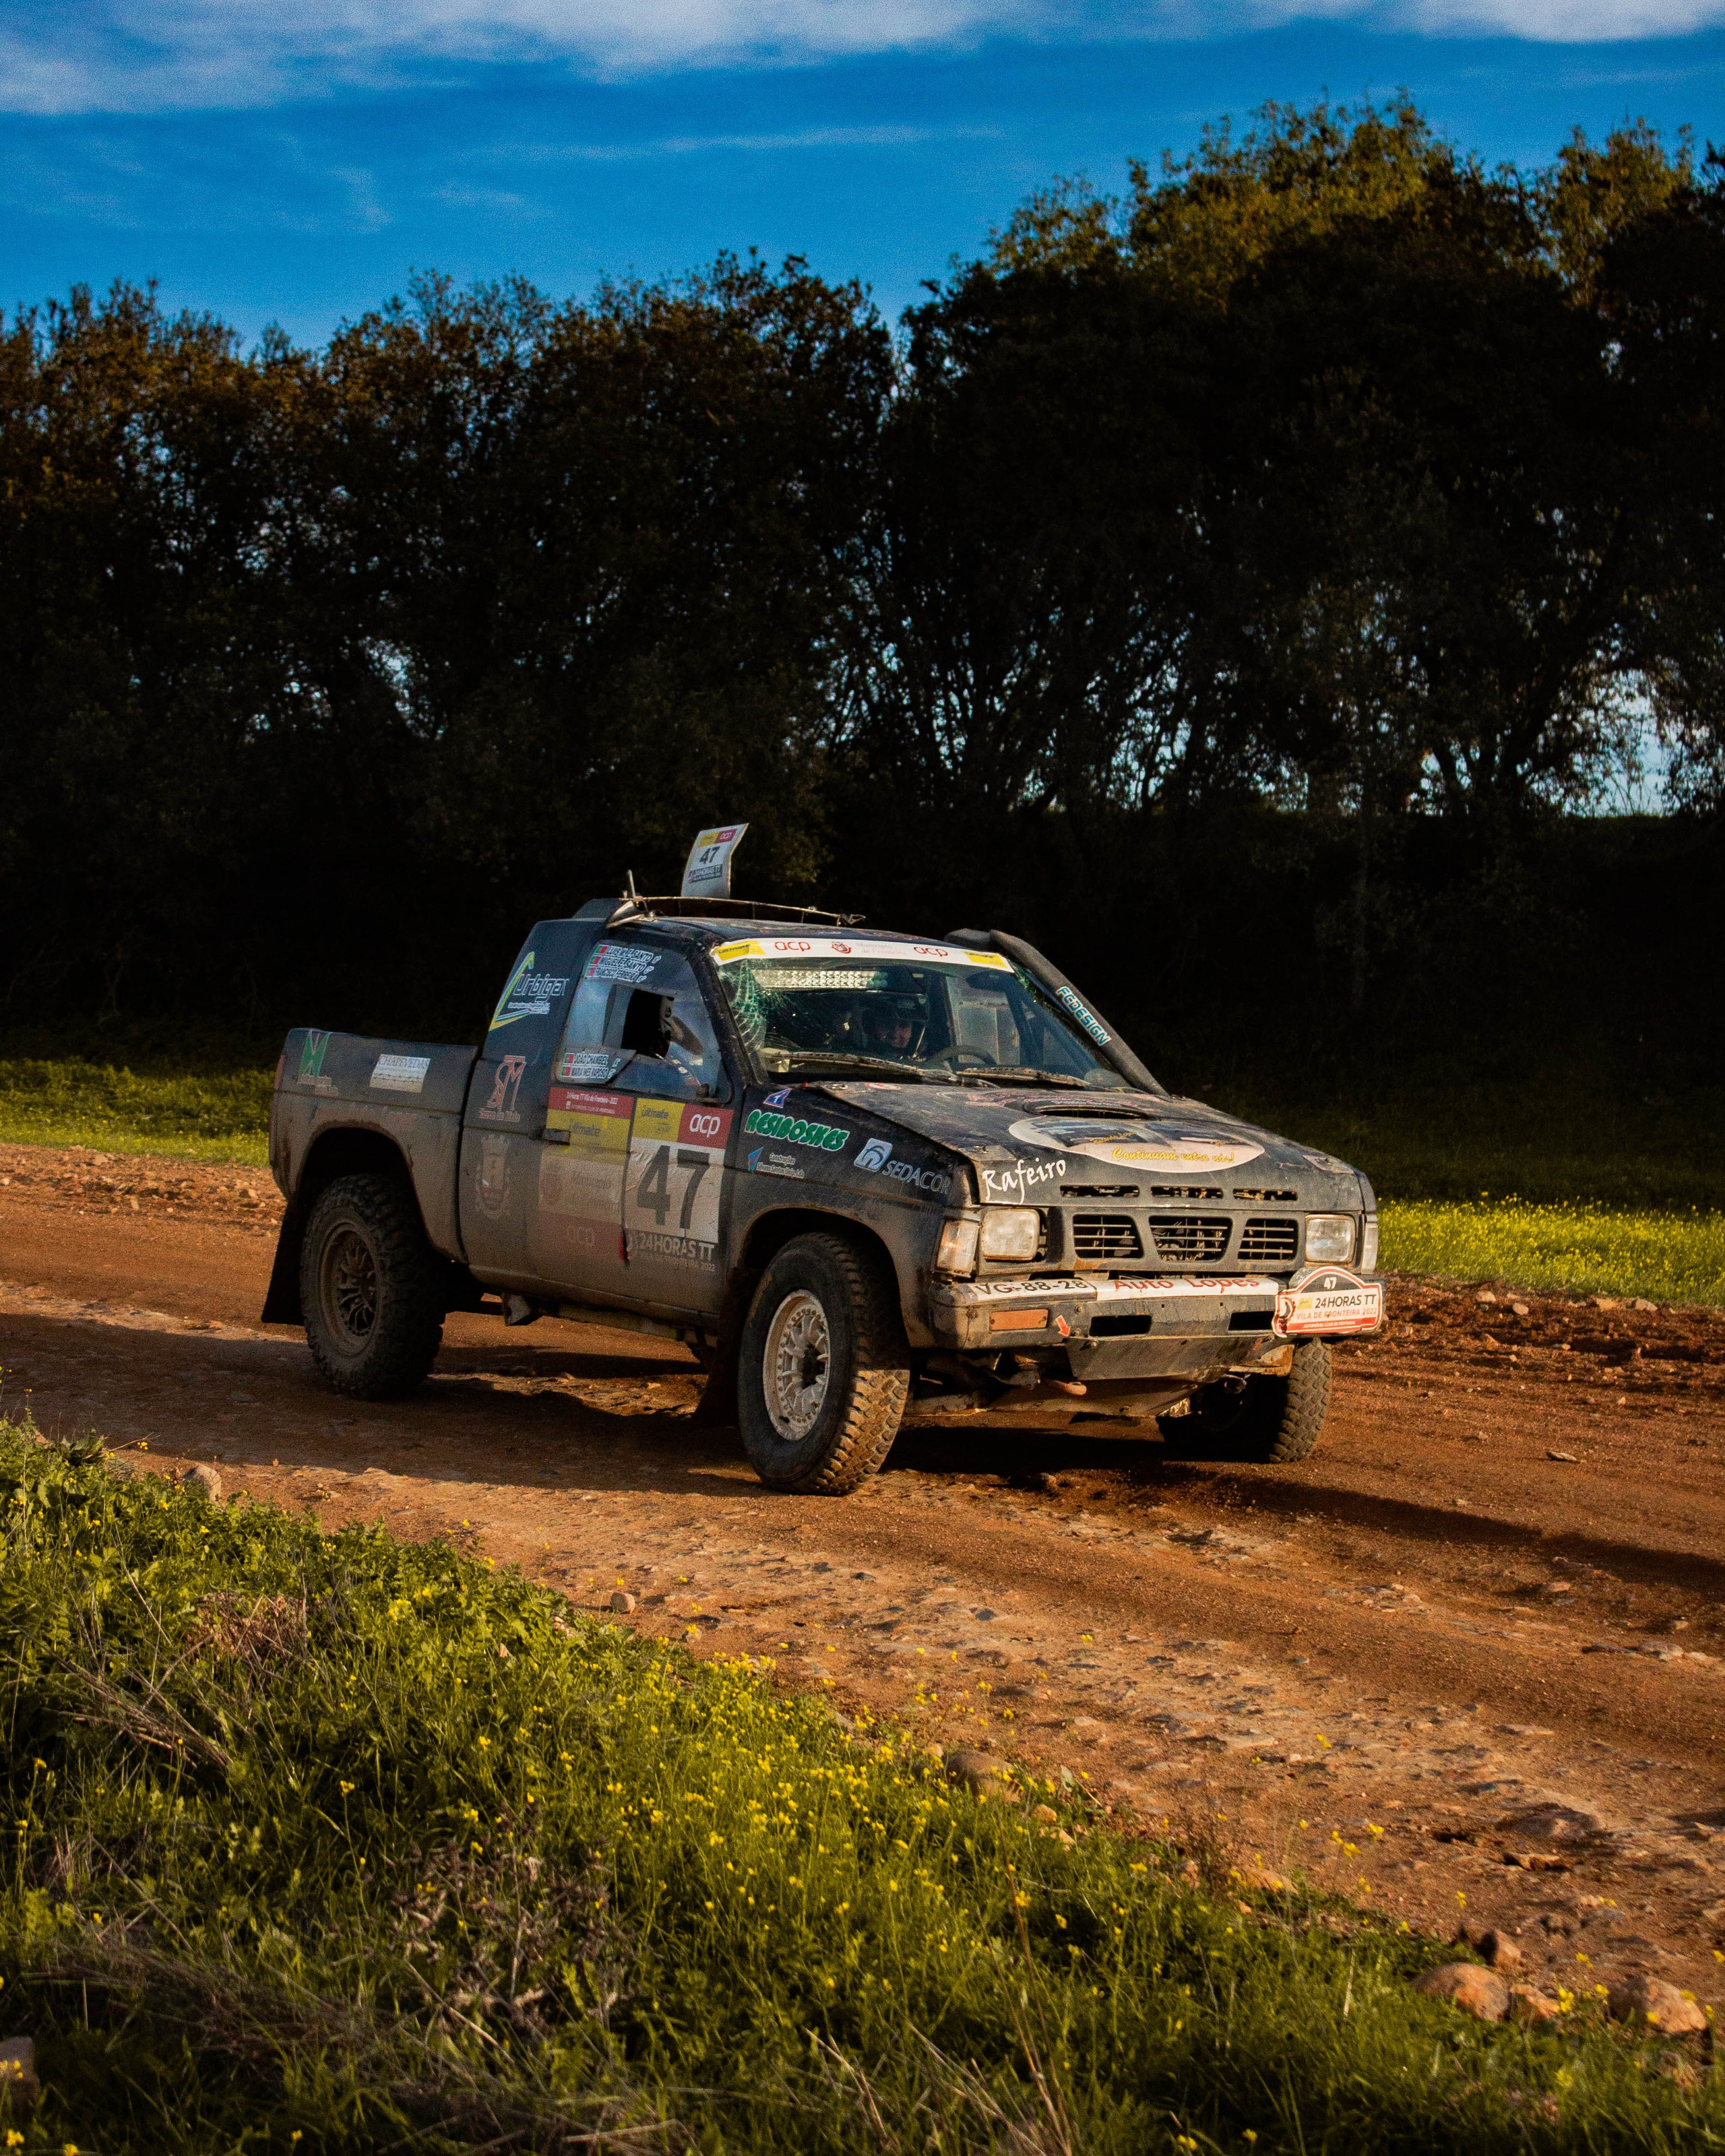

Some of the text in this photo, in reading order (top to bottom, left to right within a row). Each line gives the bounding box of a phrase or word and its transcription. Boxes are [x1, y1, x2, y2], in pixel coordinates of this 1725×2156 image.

[699, 846, 720, 864] 47
[774, 941, 811, 951] acp
[913, 947, 948, 957] acp
[689, 1114, 720, 1138] acp
[1112, 1147, 1178, 1162] Continuam
[1181, 1153, 1210, 1162] entre
[882, 1160, 951, 1195] SEDACOR
[982, 1159, 1066, 1205] Rafeiro
[637, 1145, 710, 1230] 47
[1115, 1278, 1259, 1294] Auto Lopes
[1323, 1277, 1337, 1290] 47
[1365, 1294, 1377, 1305] TT
[1296, 1312, 1312, 1321] VILA
[1324, 1309, 1360, 1319] FRONTEIRA
